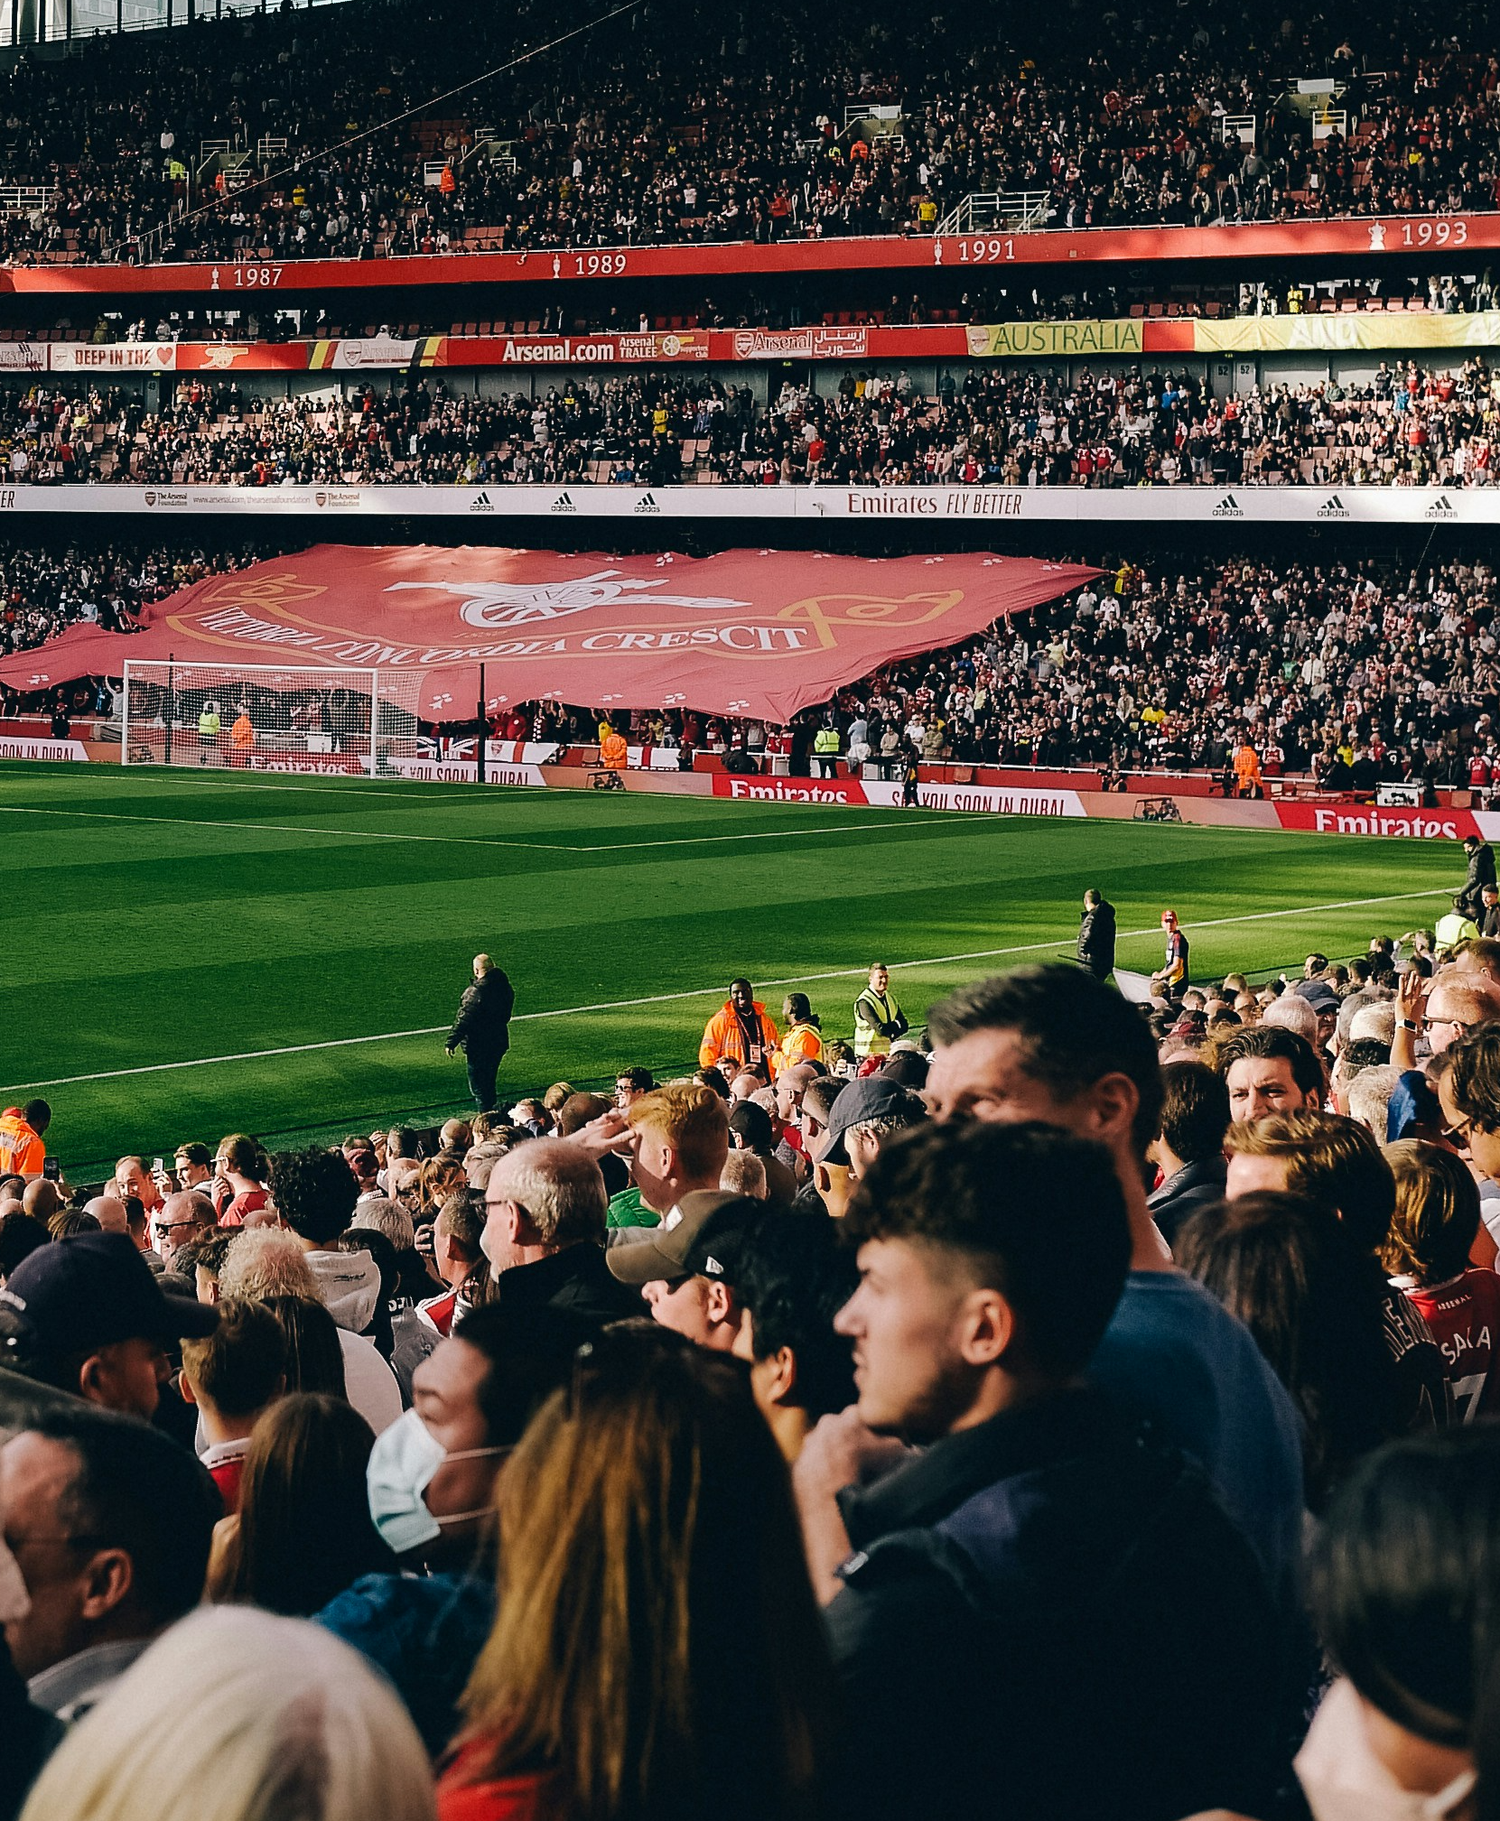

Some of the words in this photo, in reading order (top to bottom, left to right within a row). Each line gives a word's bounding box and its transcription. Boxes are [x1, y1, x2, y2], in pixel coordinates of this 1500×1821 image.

[1401, 221, 1468, 247] 1993
[957, 238, 1016, 262] 1991
[574, 254, 627, 276] 1989
[234, 267, 283, 287] 1987
[619, 335, 655, 347] Arsenal
[754, 330, 812, 350] Arsenal
[992, 322, 1139, 353] AUSTRALIA
[75, 349, 106, 365] DEEP
[109, 349, 124, 365] IN
[502, 339, 615, 362] Arsenal.com
[619, 346, 658, 359] TRALEE
[1218, 365, 1228, 376] 52
[1240, 364, 1250, 375] 52
[157, 492, 166, 500] The
[167, 492, 188, 500] Arsenal
[328, 492, 337, 500] The
[338, 492, 360, 500] Arsenal
[847, 493, 938, 514] Emirates
[946, 493, 968, 514] FLY
[971, 494, 1022, 515] BETTER
[469, 503, 495, 512] adidas
[550, 503, 577, 512] adidas
[633, 503, 661, 513] adidas
[1212, 506, 1244, 517] adidas
[1316, 507, 1350, 517] adidas
[1424, 508, 1458, 518] adidas
[196, 606, 325, 646] VICTORIA
[312, 639, 568, 665] CONCORDIA
[582, 626, 808, 652] CRESCIT
[729, 779, 848, 803] Emirates
[1314, 809, 1458, 839] Emirates
[1437, 1293, 1472, 1311] ARSENAL
